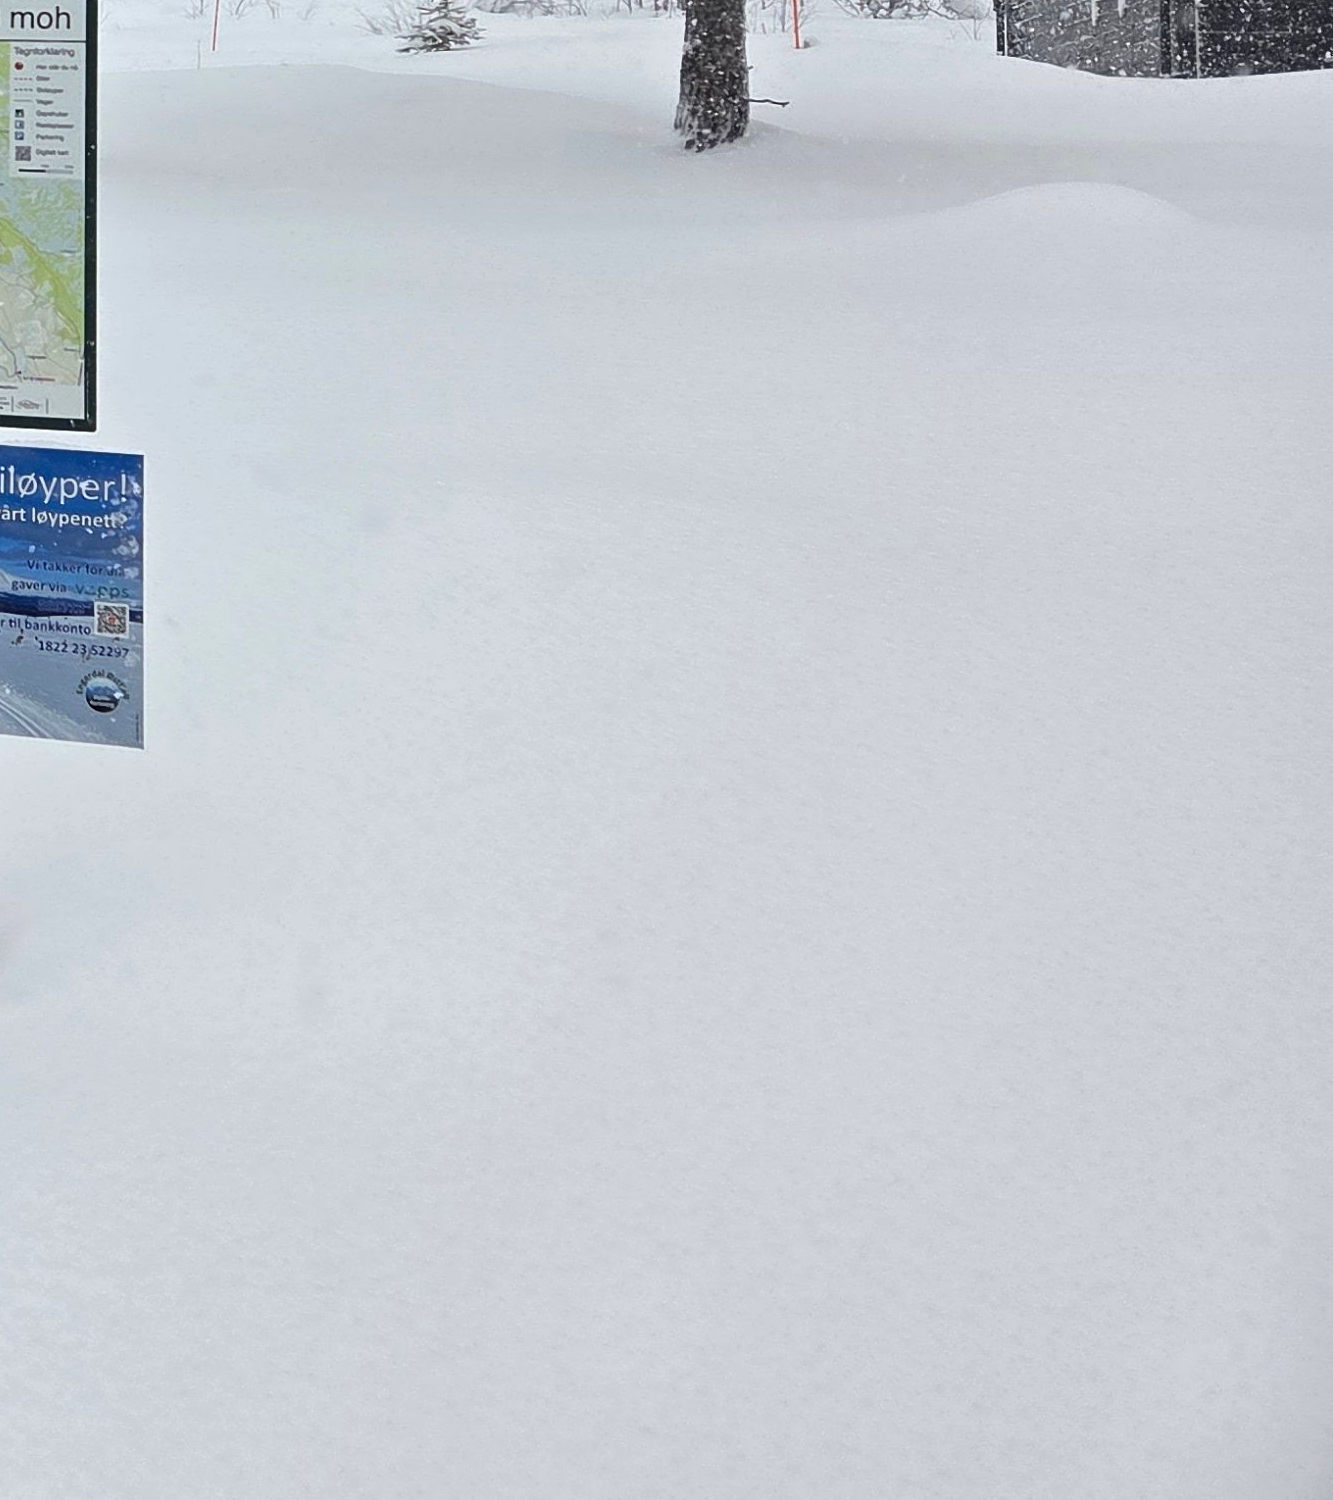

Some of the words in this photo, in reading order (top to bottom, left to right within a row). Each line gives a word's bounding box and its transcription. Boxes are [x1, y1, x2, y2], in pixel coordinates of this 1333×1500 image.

[10, 6, 71, 29] moh
[27, 560, 41, 571] Vi
[43, 561, 81, 574] takker
[85, 564, 103, 576] for
[11, 578, 46, 591] gaver
[48, 582, 67, 593] via
[9, 618, 22, 629] til
[25, 618, 92, 636] bankkonto
[38, 640, 69, 653] 1822
[72, 643, 87, 655] 23
[91, 645, 129, 659] 52297
